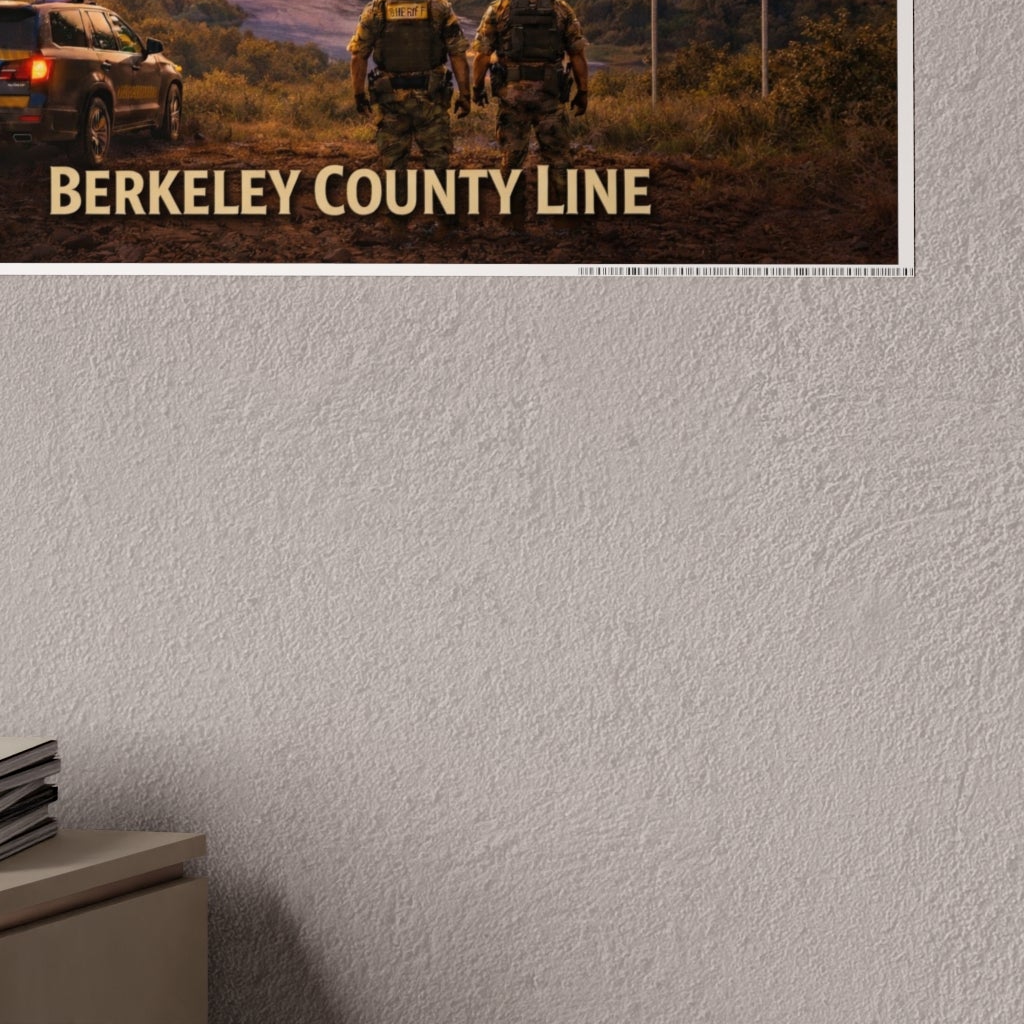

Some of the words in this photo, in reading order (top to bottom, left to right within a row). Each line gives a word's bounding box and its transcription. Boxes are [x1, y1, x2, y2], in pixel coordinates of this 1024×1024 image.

[50, 166, 300, 215] BERKELEY
[314, 165, 524, 216] COUNTY
[536, 165, 652, 215] LINE
